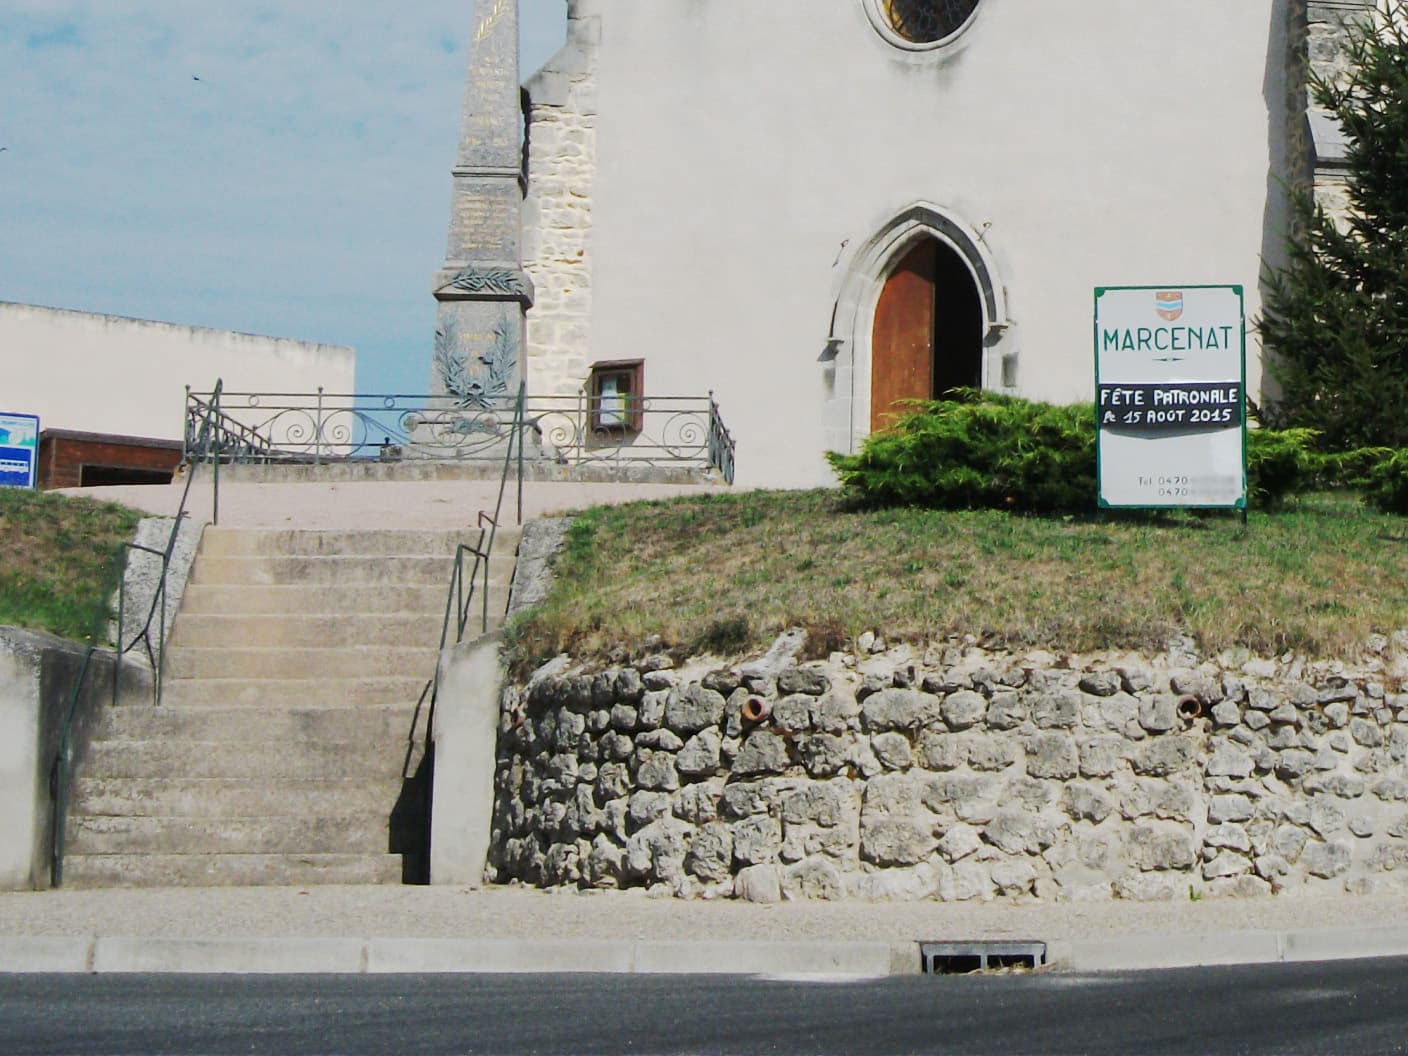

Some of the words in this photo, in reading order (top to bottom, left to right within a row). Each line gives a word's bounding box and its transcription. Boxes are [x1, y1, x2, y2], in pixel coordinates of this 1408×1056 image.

[1103, 326, 1233, 351] MARCENAT
[1100, 387, 1145, 406] FÊTE
[1153, 388, 1238, 406] PATRONALE
[1123, 410, 1143, 424] 15
[1190, 408, 1233, 422] 2015
